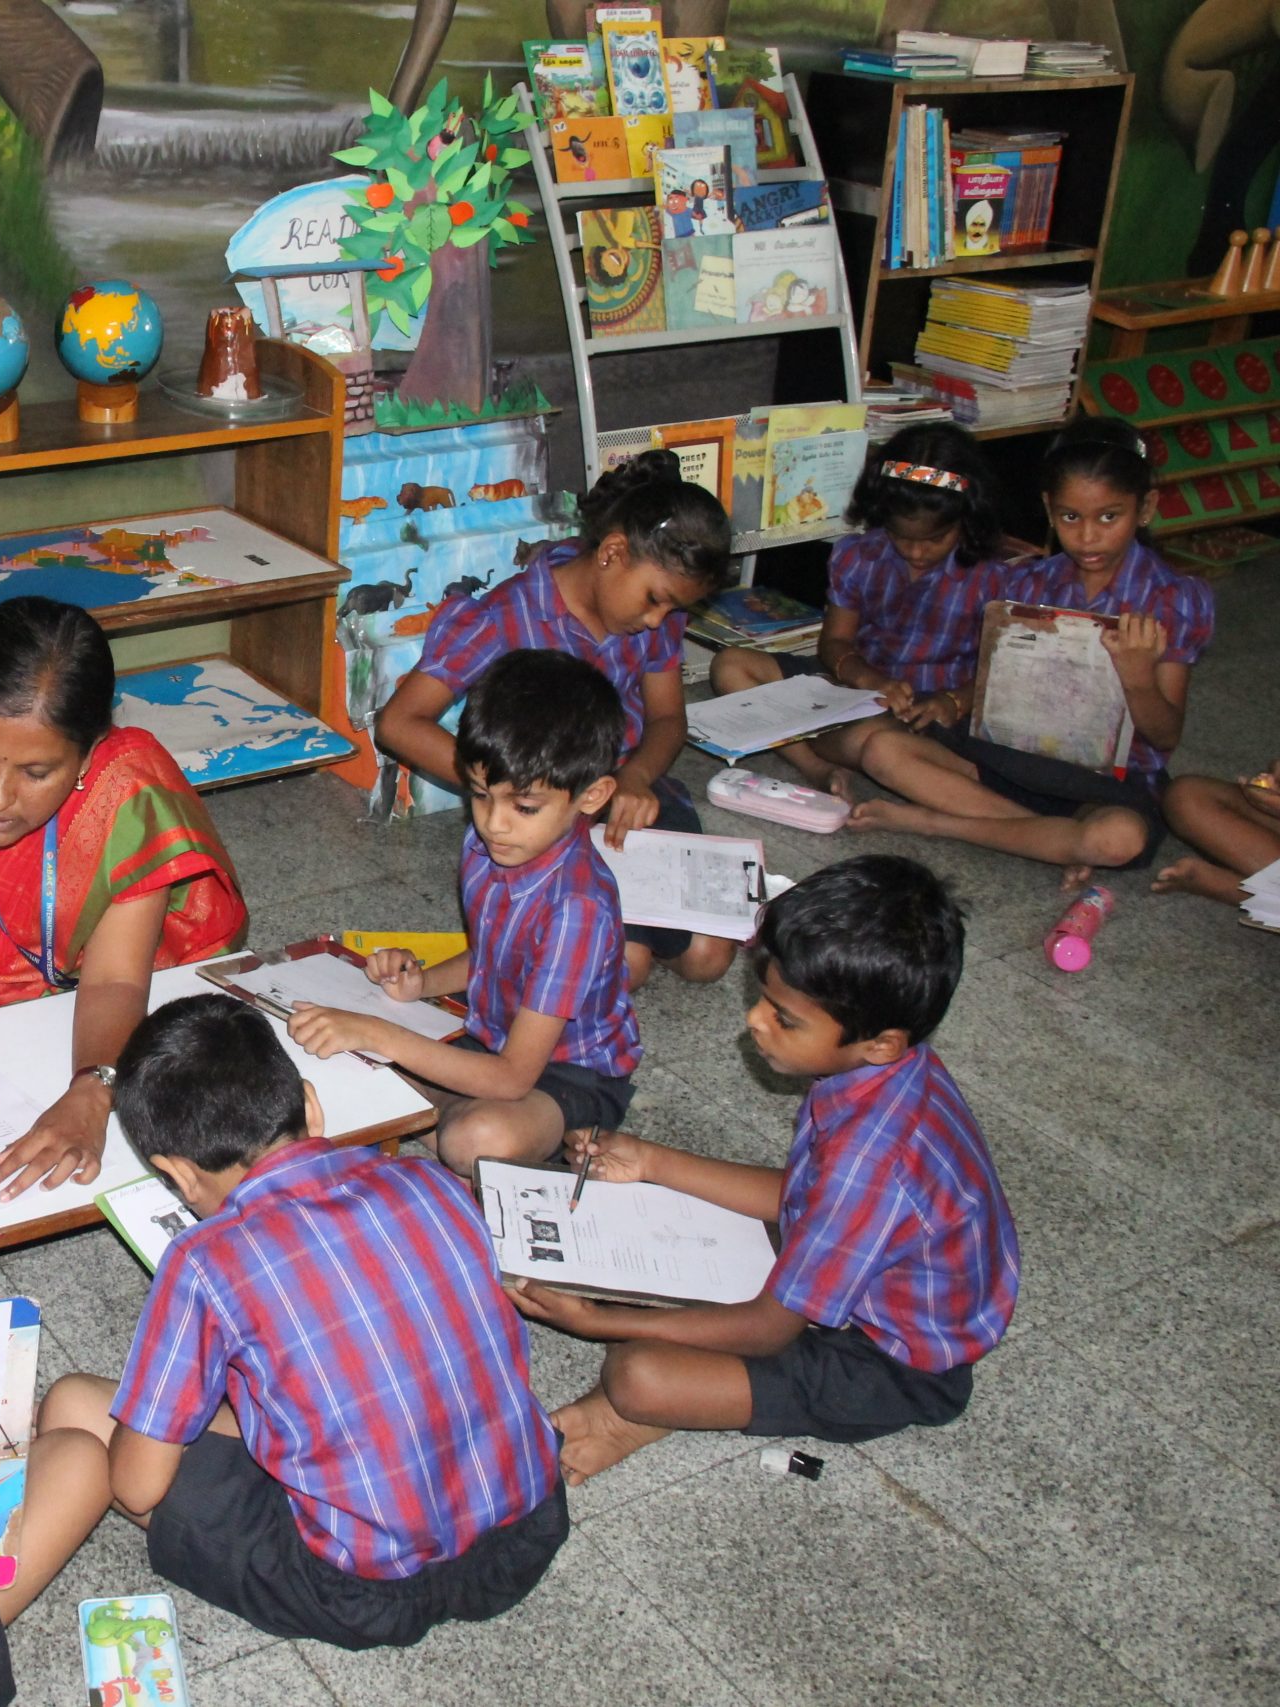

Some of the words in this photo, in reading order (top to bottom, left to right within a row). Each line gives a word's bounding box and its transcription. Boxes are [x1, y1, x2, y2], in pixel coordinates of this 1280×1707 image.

[740, 183, 801, 216] ANGRY
[680, 452, 707, 463] CHEEP
[46, 862, 54, 897] ABACUS
[46, 902, 54, 949] INTERNATIONAL
